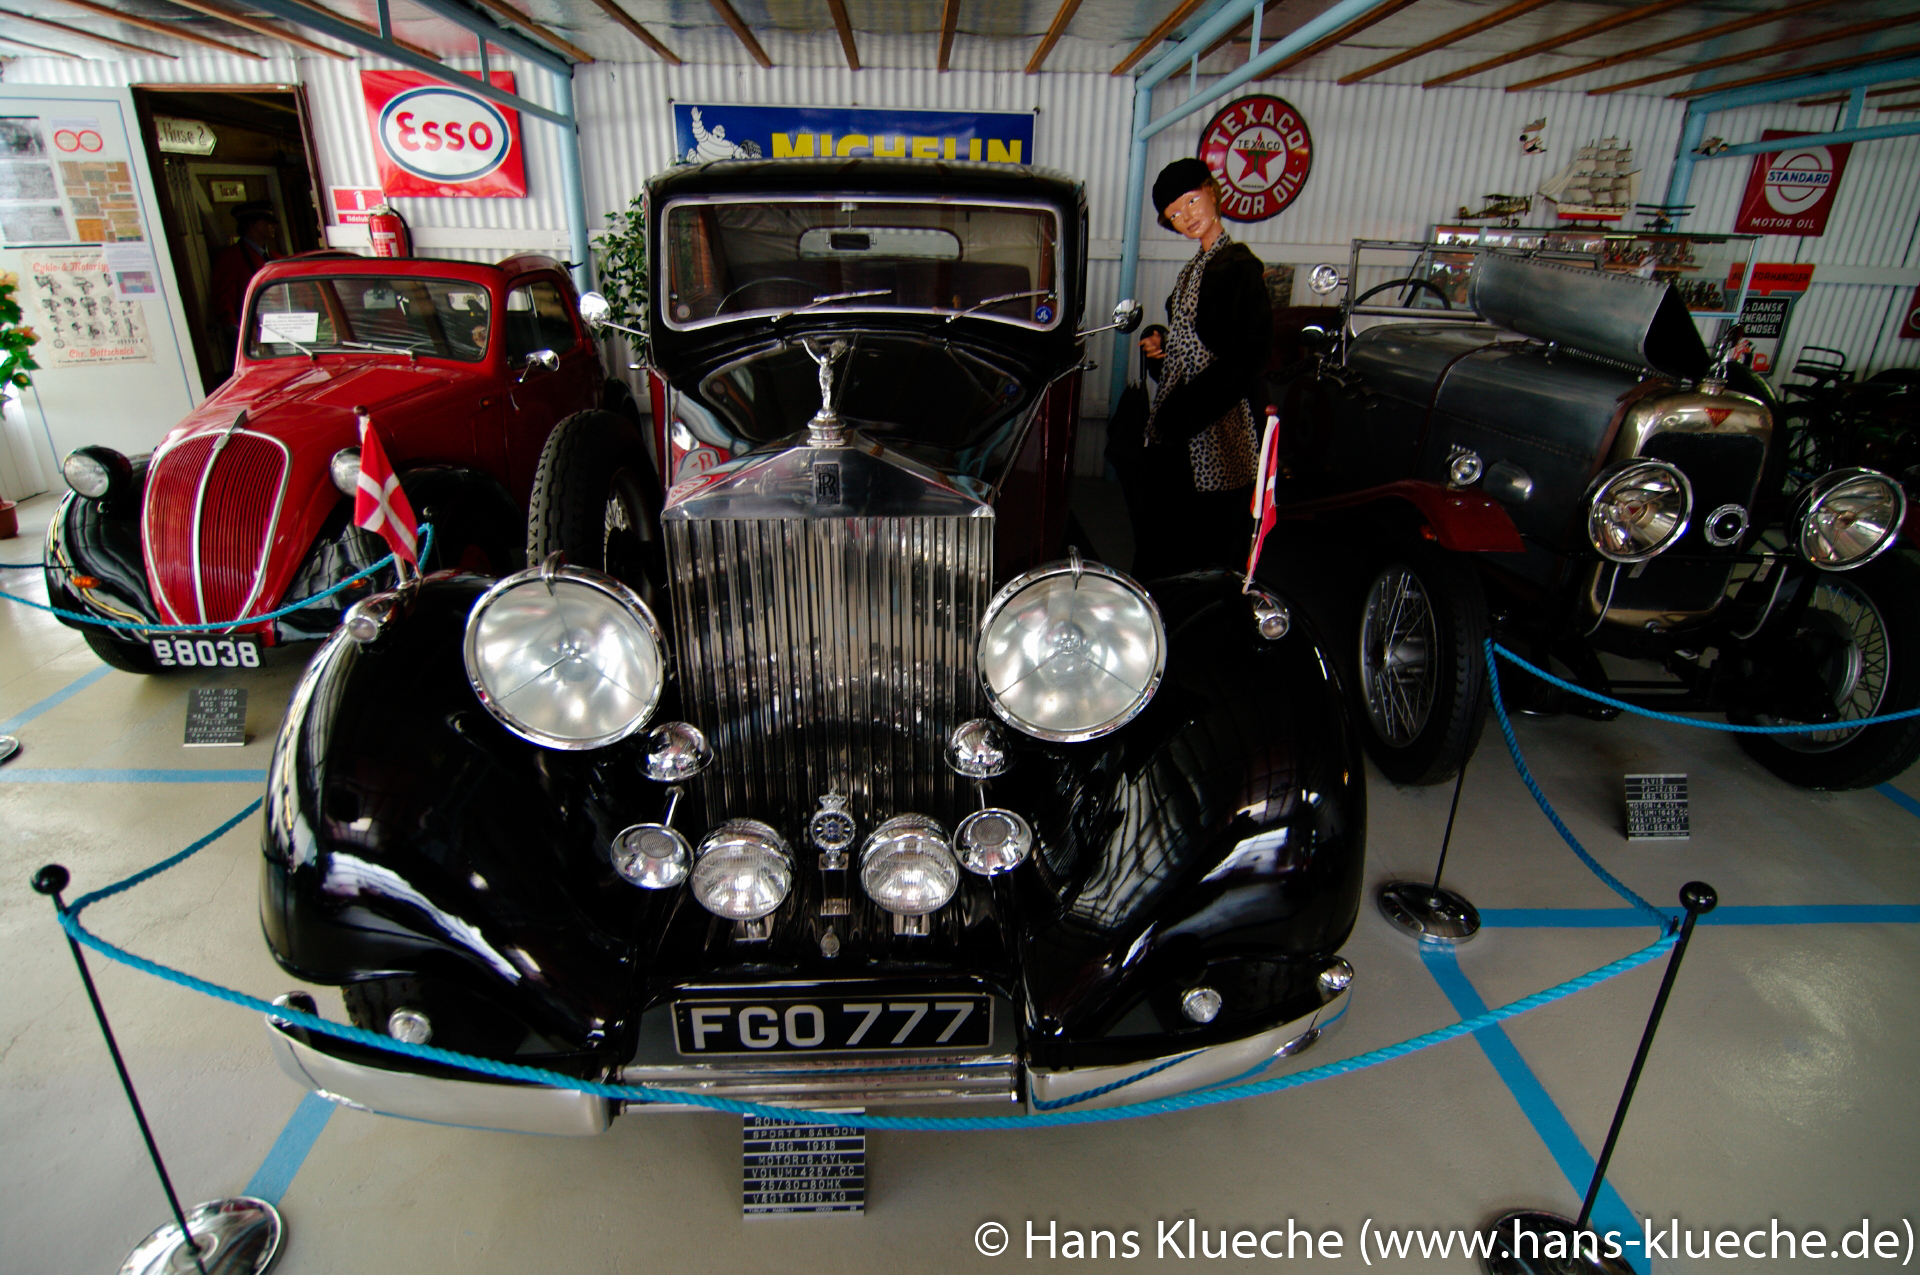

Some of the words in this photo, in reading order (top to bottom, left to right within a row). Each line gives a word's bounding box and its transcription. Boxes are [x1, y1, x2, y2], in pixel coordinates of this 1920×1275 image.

[1208, 103, 1304, 151] TEXACO
[771, 132, 1023, 164] MICHELIN
[1237, 139, 1281, 151] TEXACO
[1767, 171, 1830, 184] STANDARD
[1272, 171, 1302, 204] OIL
[1750, 217, 1792, 228] MOTOR
[1796, 218, 1815, 229] OIL
[1753, 271, 1810, 282] FORHANDLER
[1751, 301, 1785, 312] DANSK
[1740, 312, 1782, 323] ENERATOR
[198, 688, 215, 696] FIAT
[691, 1004, 825, 1050] FGO
[842, 1001, 975, 1046] 777
[806, 1140, 836, 1151] 1938
